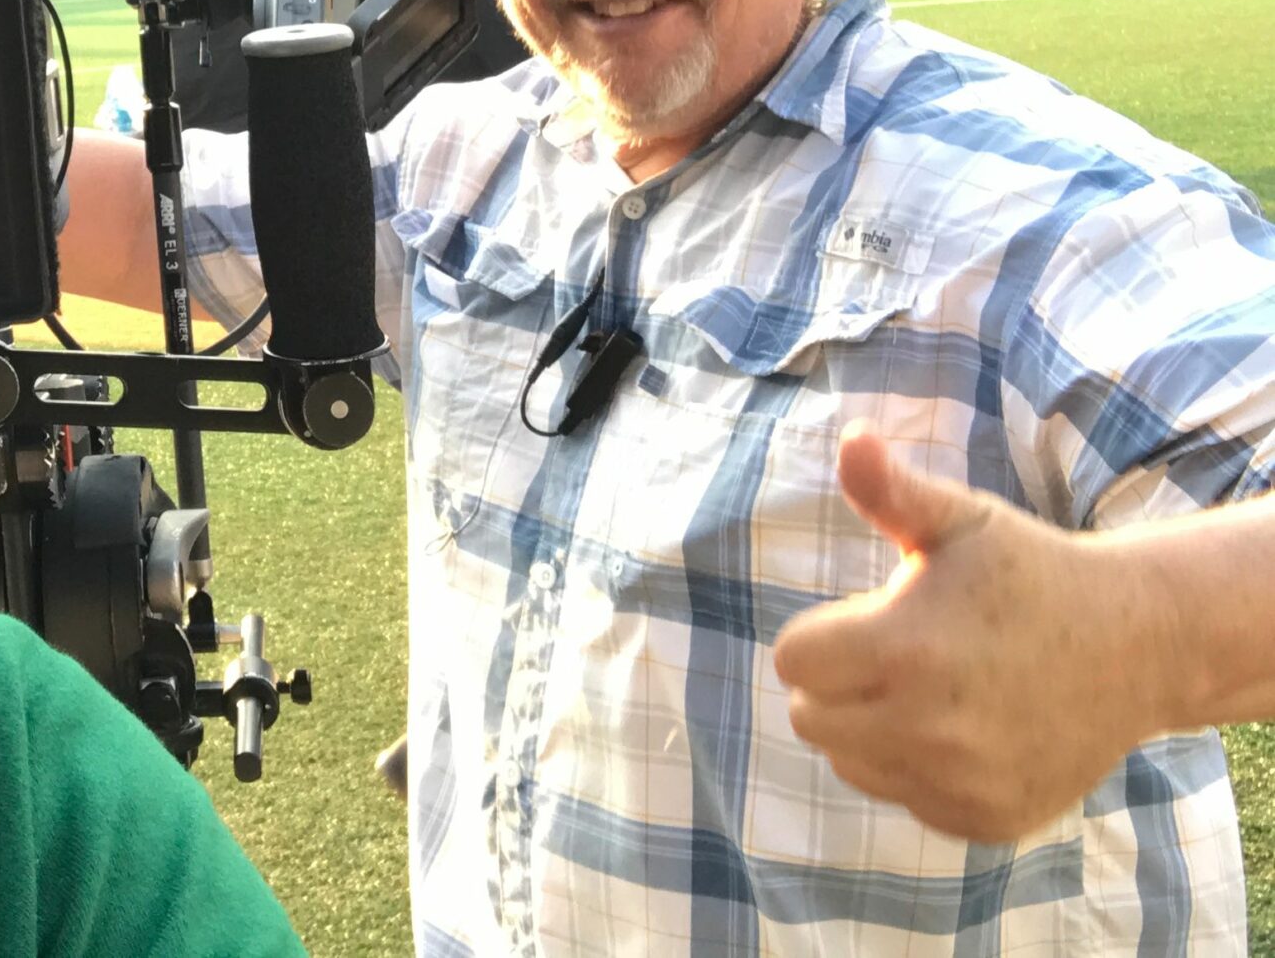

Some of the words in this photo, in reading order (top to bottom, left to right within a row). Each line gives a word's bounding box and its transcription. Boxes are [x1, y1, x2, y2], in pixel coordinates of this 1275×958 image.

[860, 229, 892, 248] mbia
[165, 240, 177, 256] EL
[166, 262, 178, 270] 3
